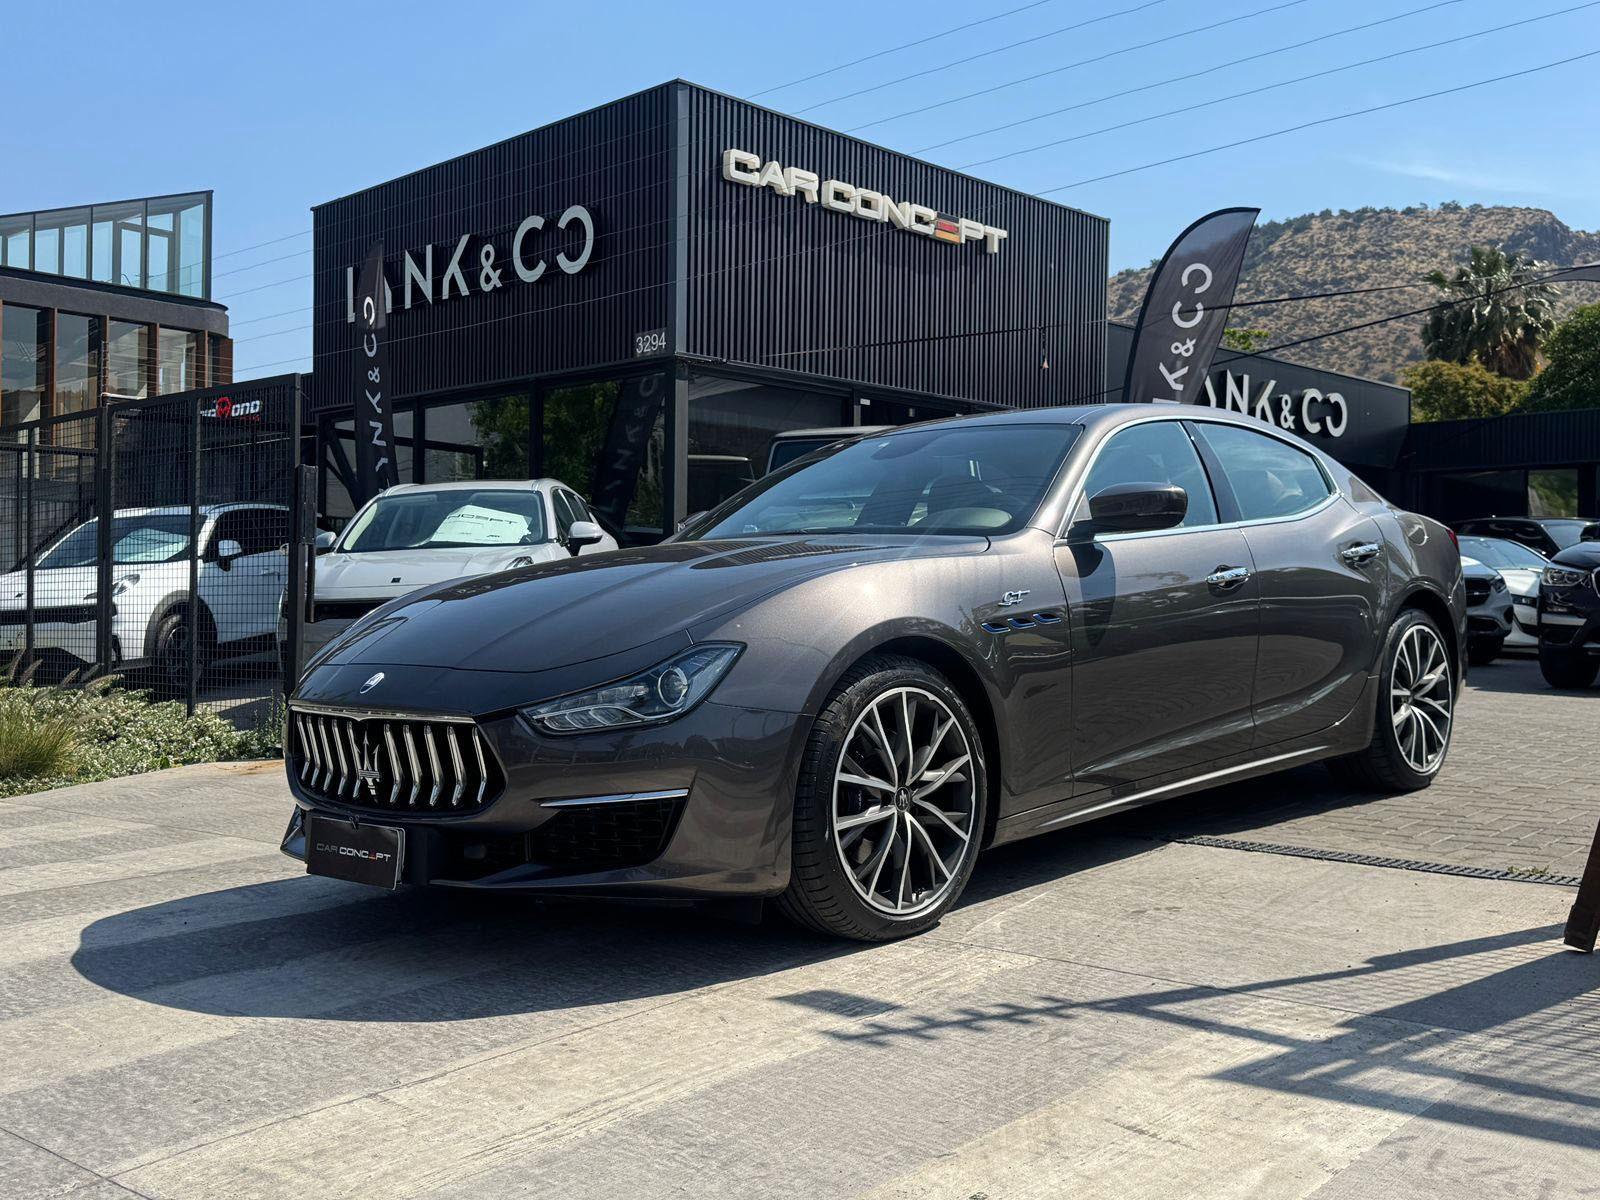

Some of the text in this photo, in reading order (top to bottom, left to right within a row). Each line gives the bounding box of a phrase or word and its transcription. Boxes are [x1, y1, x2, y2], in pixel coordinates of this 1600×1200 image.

[722, 148, 1008, 254] CAR CONCEPT
[635, 332, 667, 354] 3294
[316, 842, 338, 854] CAR
